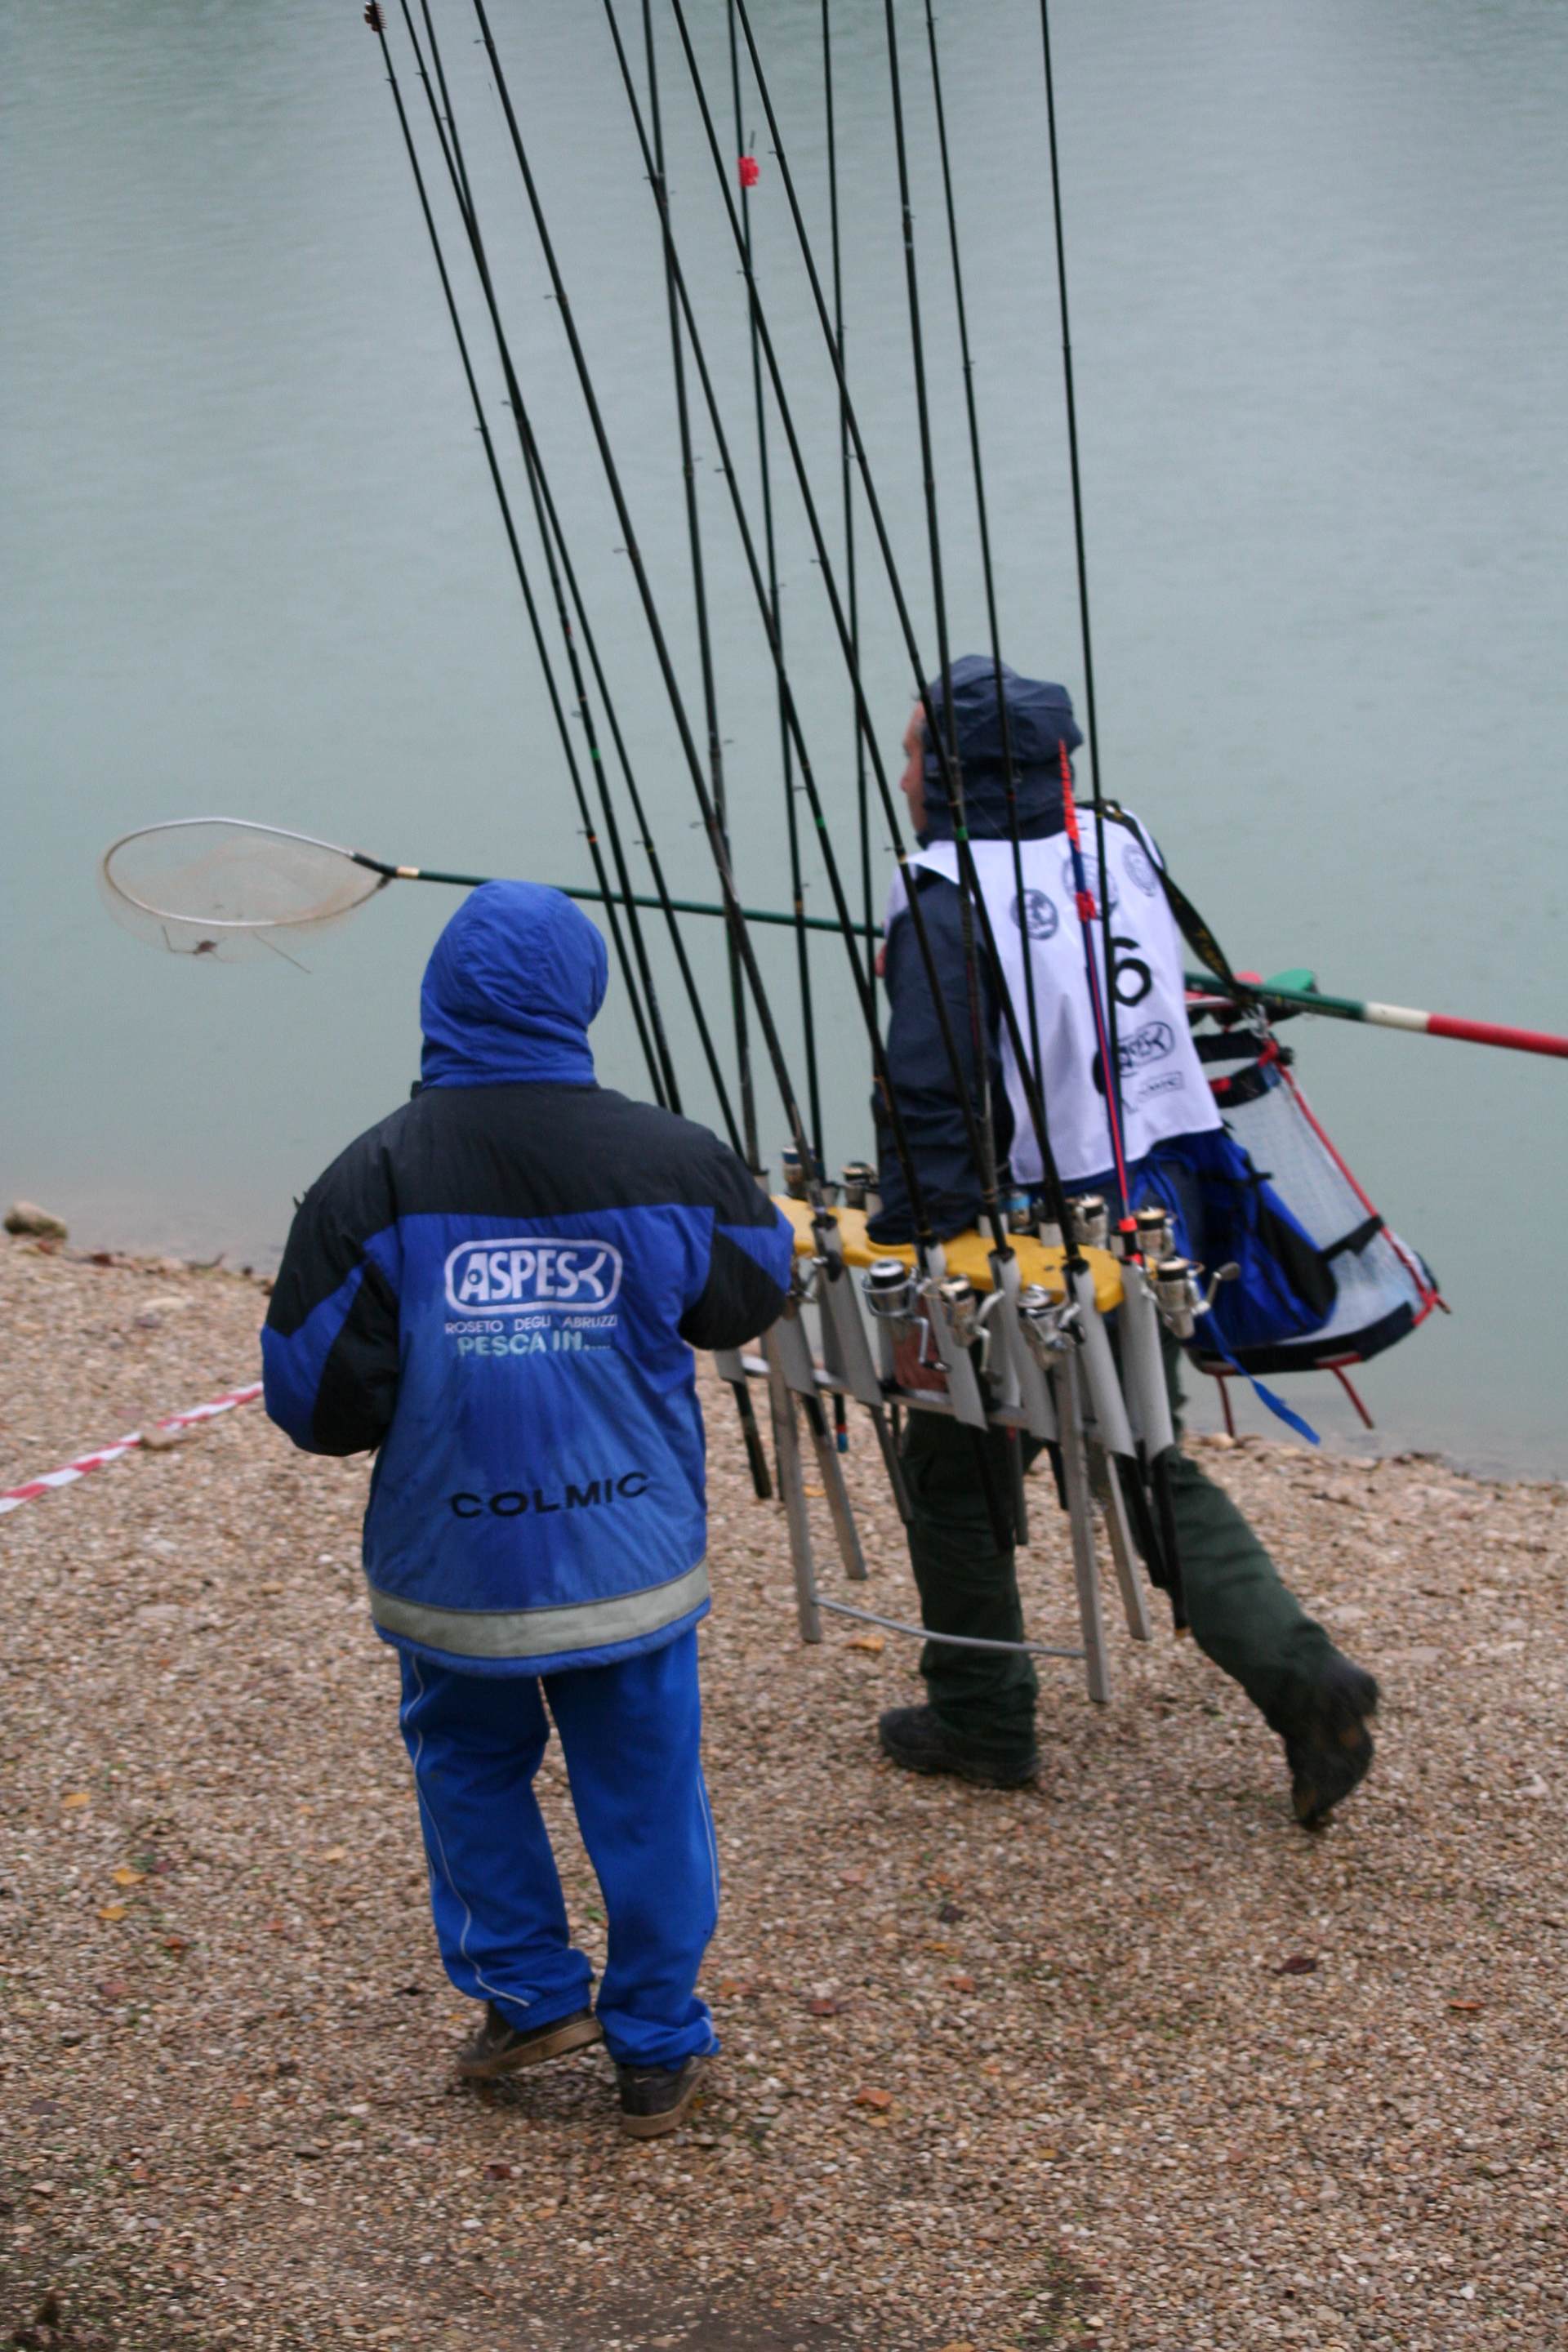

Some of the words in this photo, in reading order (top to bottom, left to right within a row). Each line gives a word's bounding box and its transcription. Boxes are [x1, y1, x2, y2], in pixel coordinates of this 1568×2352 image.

[1108, 937, 1152, 1007] 6
[445, 1320, 504, 1334] ROSETO
[514, 1316, 551, 1331] DEGLI
[563, 1315, 617, 1328] ABRUZZI
[457, 1332, 546, 1356] PESCA
[451, 1472, 648, 1518] COLMIC
